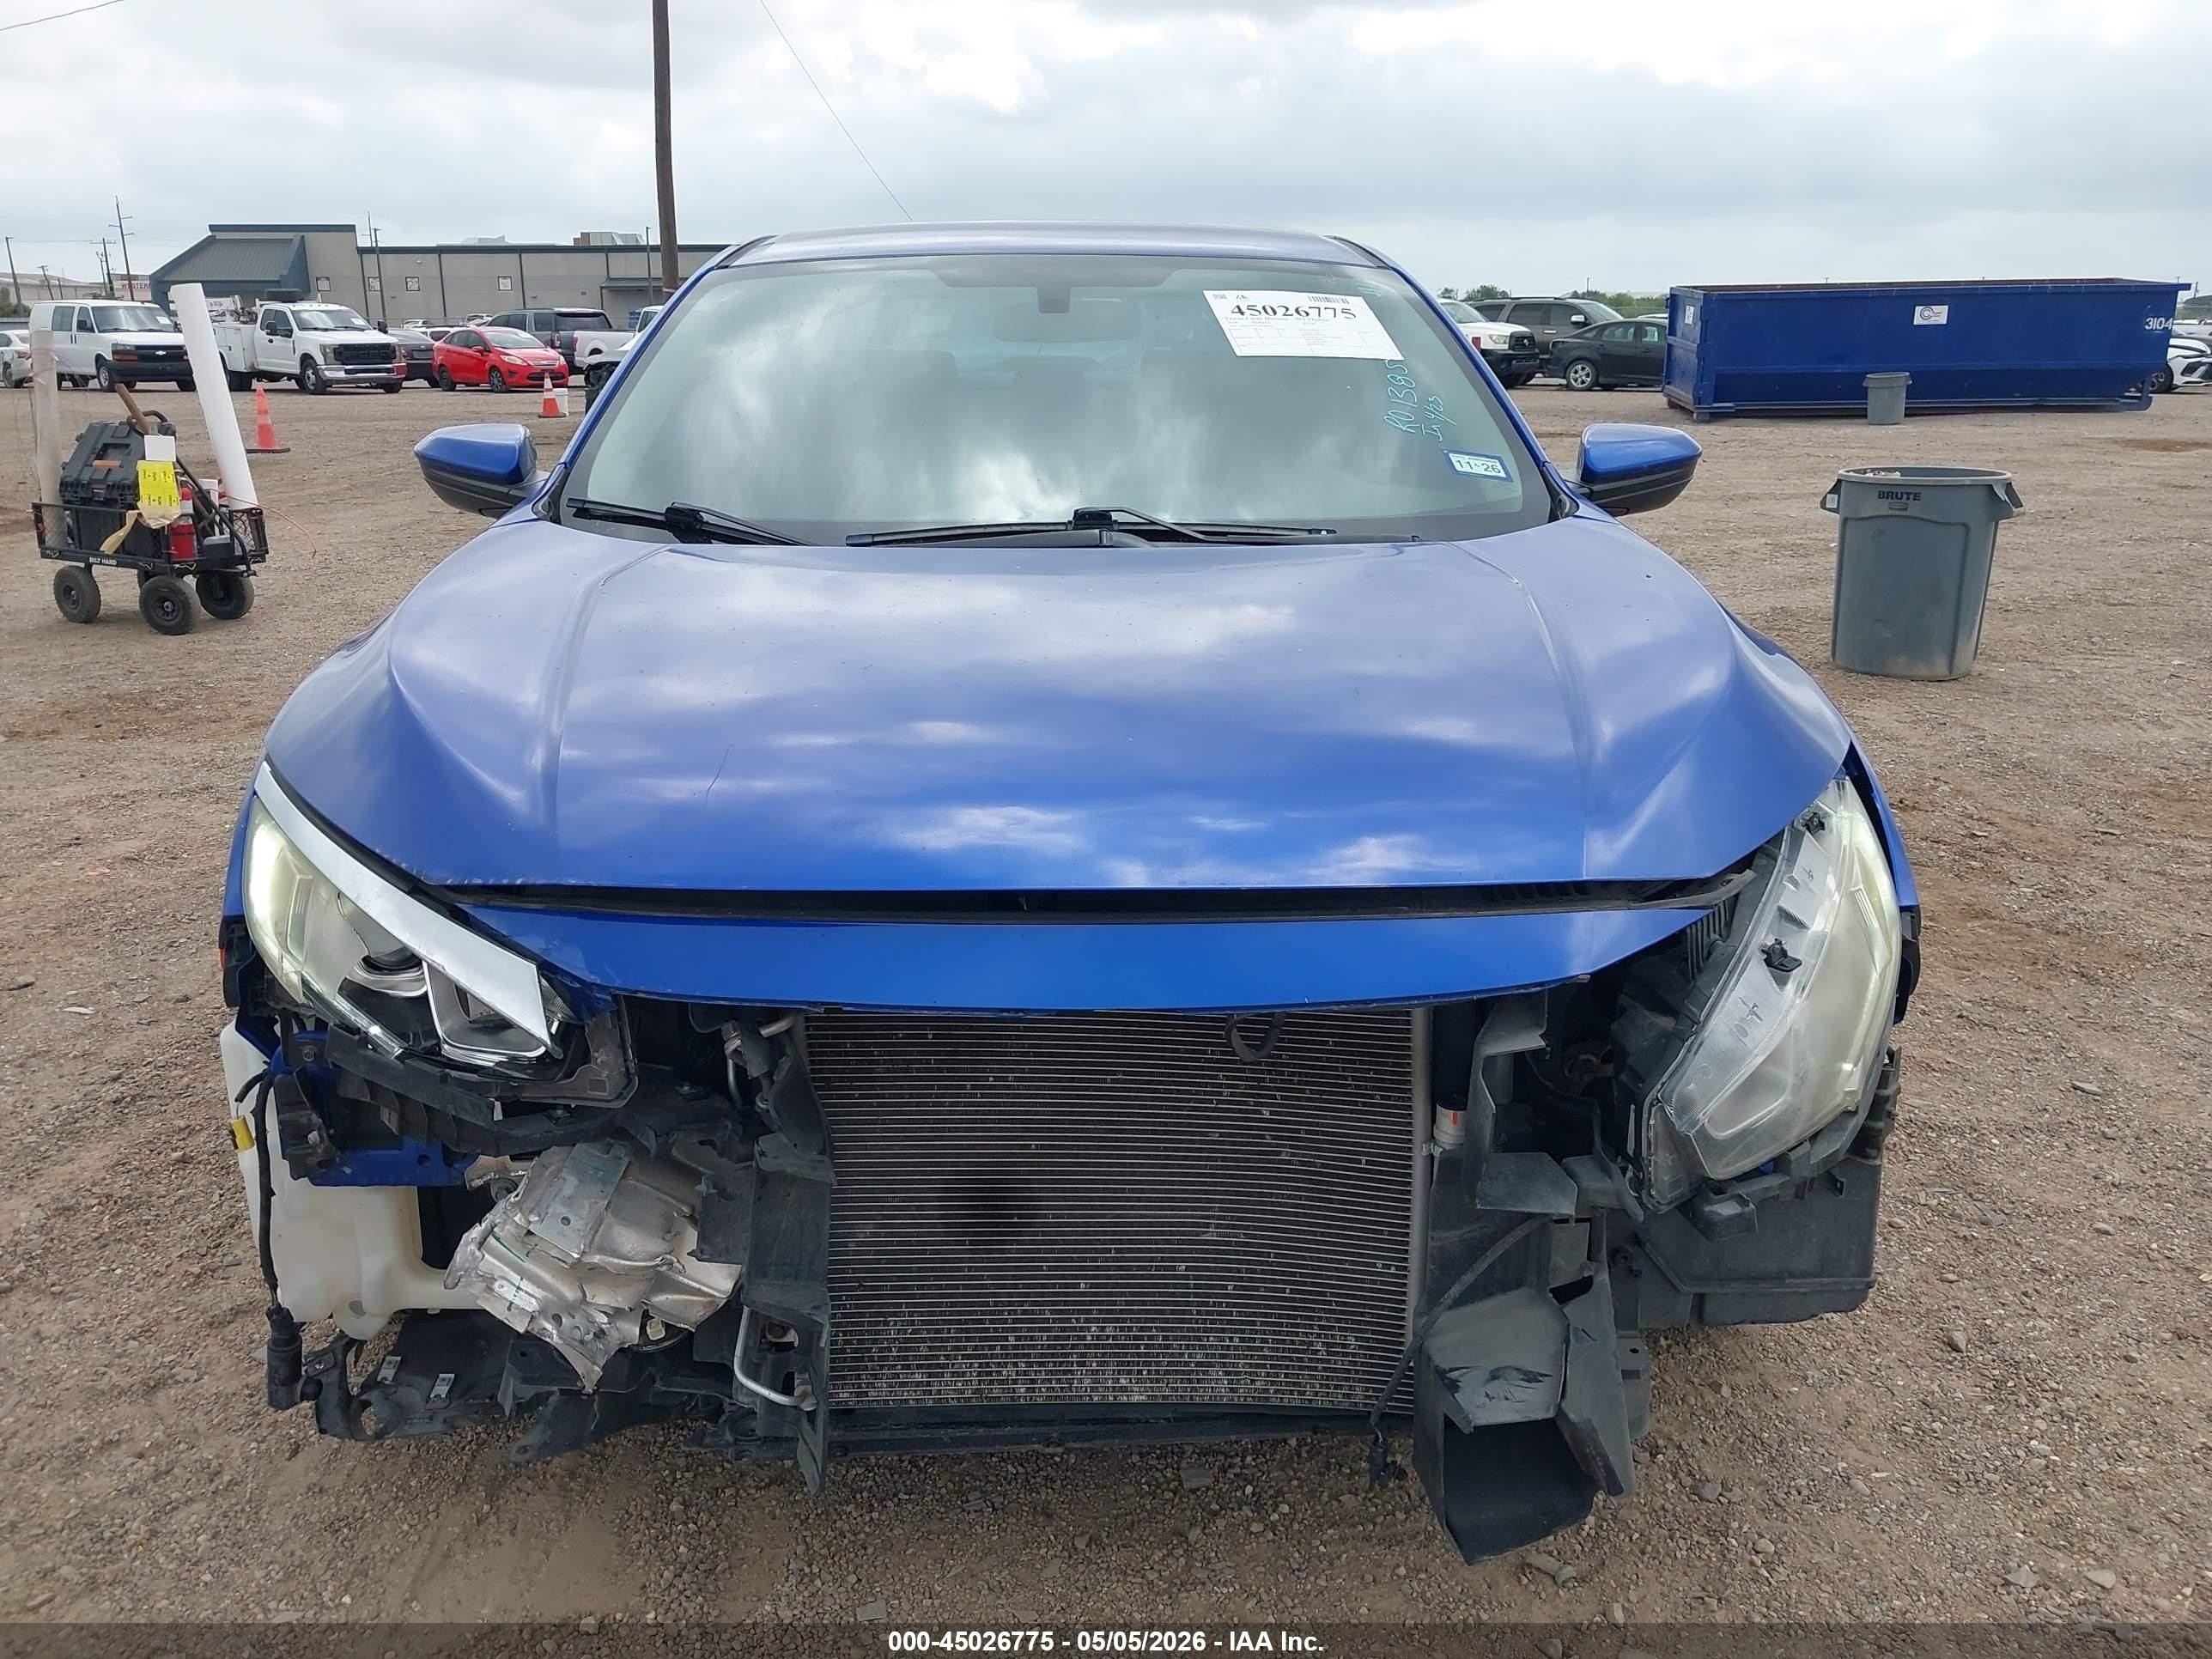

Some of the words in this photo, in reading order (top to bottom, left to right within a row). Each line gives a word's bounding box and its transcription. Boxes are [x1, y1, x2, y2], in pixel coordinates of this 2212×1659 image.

[1231, 304, 1357, 319] 45026775
[2144, 317, 2173, 331] 3104
[1877, 490, 1922, 501] BRUTE
[101, 557, 118, 566] HARD
